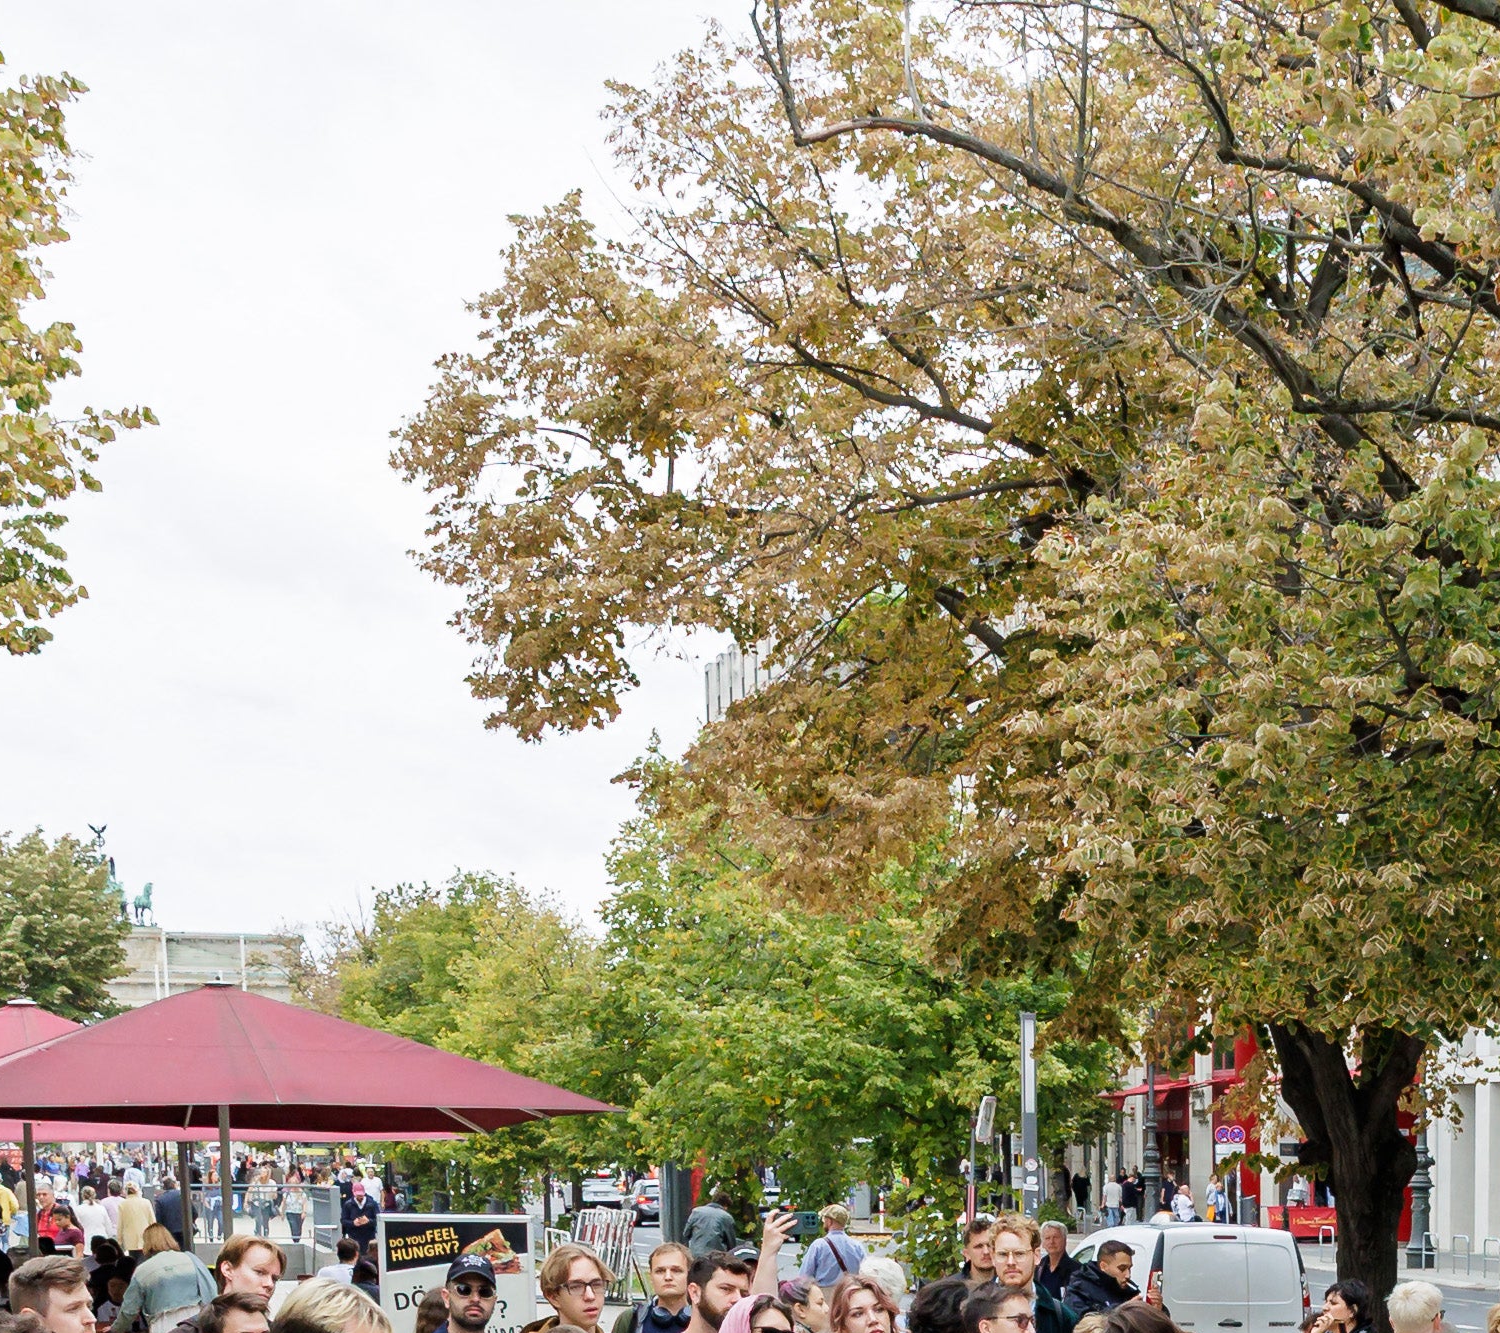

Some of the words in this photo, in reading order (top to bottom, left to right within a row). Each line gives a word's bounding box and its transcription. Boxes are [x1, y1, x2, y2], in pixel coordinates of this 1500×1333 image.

[389, 1238, 404, 1248] DO
[406, 1234, 425, 1245] YOU
[425, 1227, 458, 1242] FEEL
[391, 1241, 460, 1262] HUNGRY?
